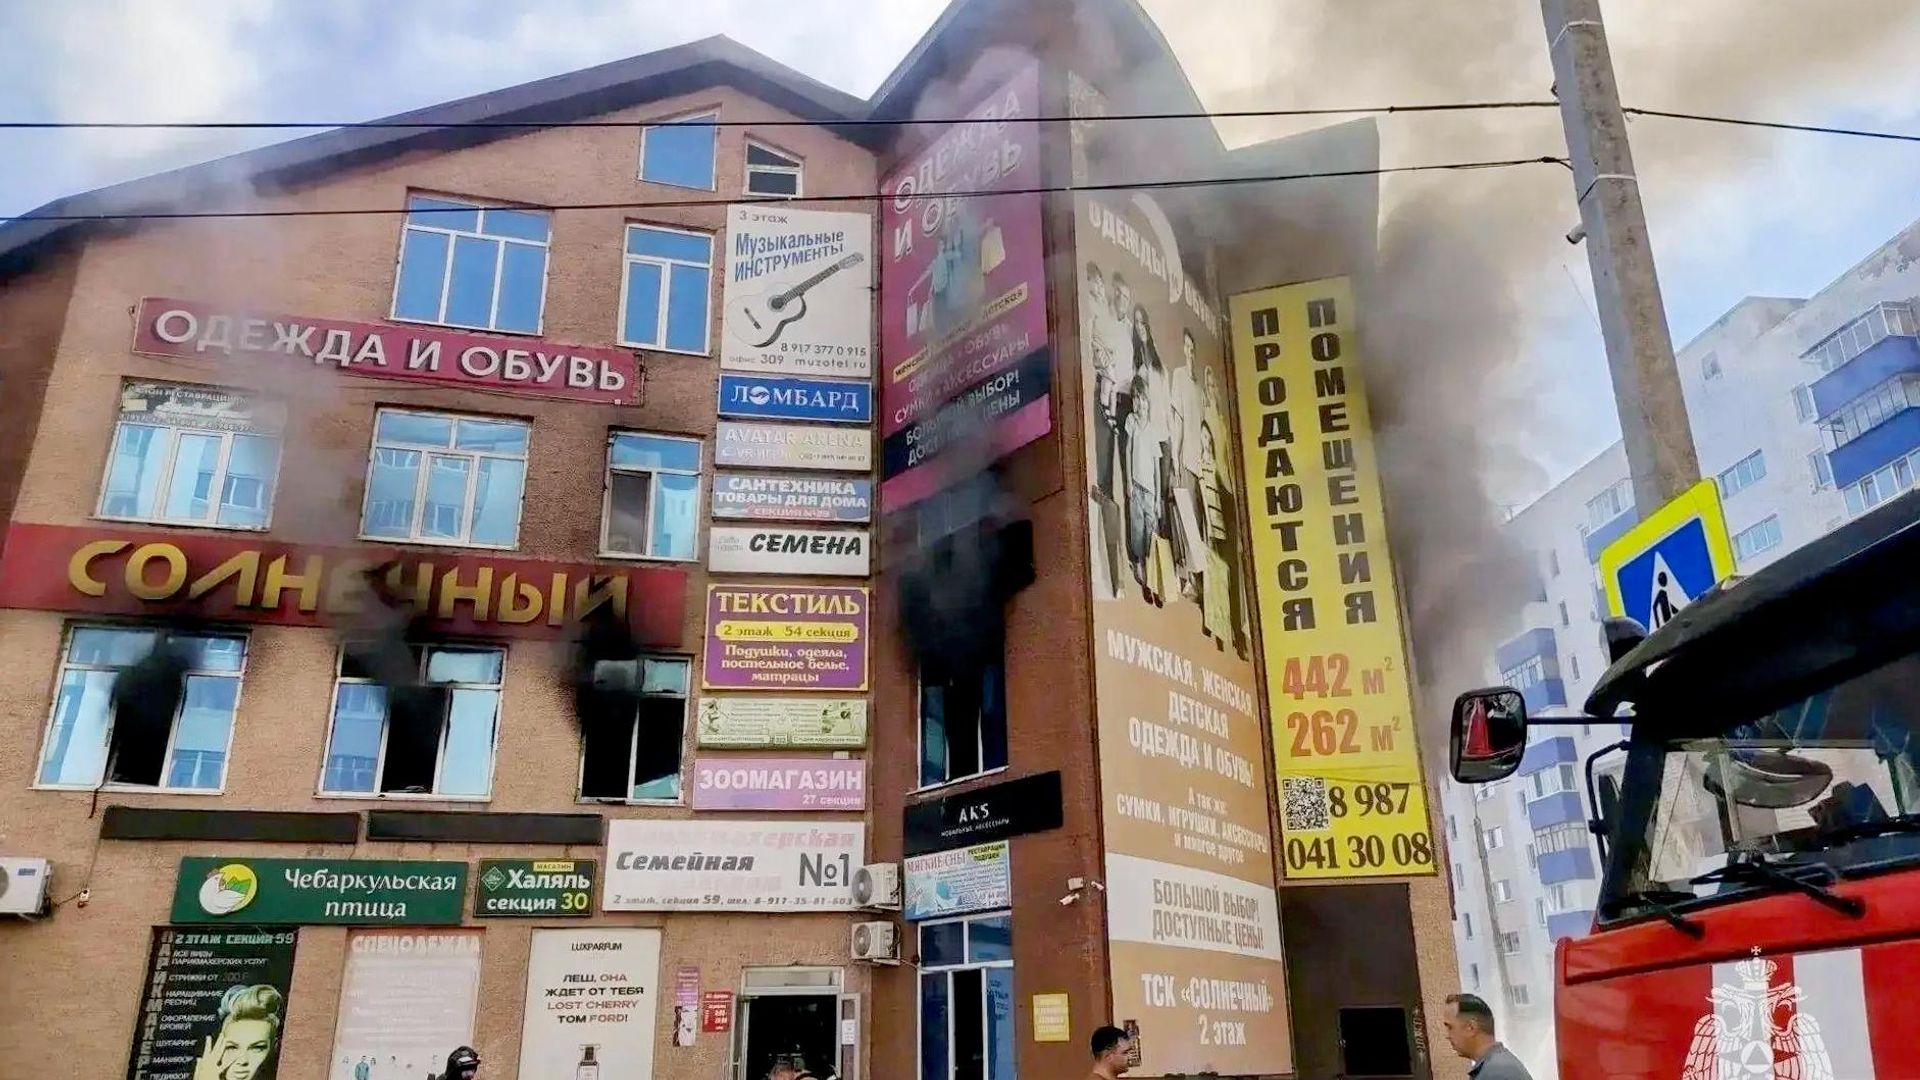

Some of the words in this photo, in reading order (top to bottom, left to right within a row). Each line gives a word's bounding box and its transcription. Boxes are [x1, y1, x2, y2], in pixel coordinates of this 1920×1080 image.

[739, 211, 748, 221] 3
[751, 215, 788, 225] этаж
[735, 231, 844, 258] Музыкальные
[894, 219, 912, 263] И
[734, 243, 844, 282] ИНСТРУМЕНТЫ
[155, 308, 388, 367] ОДЕЖДА
[408, 339, 442, 372] И
[461, 345, 627, 392] ОБУВЬ
[760, 354, 785, 365] 309
[780, 342, 788, 352] 8
[791, 344, 810, 353] 917
[814, 345, 834, 354] 377
[836, 346, 843, 356] 0
[847, 346, 866, 357] 915
[795, 357, 866, 369] muzotel.ru
[1251, 307, 1316, 632] ПРОДАЮТСЯ
[1307, 297, 1377, 624] ПОМЕЩЕНИЯ
[728, 477, 857, 495] САНТЕХНИКА
[716, 492, 783, 504] ТОВАРЫ
[785, 493, 822, 508] ДЛЯ
[821, 497, 868, 508] ДОМА
[749, 533, 861, 556] СЕМЕНА
[716, 592, 861, 615] ТЕКСТИЛЬ
[723, 625, 732, 635] 2
[736, 626, 773, 637] этаж
[784, 625, 802, 636] 54
[805, 627, 850, 639] секция
[725, 645, 793, 659] Подушки,
[797, 648, 848, 660] одеяла,
[722, 659, 804, 669] постельное
[751, 672, 820, 683] матрацы
[1106, 629, 1198, 691] МУЖСКАЯ,
[1202, 667, 1257, 724] ЖЕНСКАЯ,
[1282, 653, 1352, 700] 442
[1169, 690, 1229, 740] ДЕТСКАЯ
[1128, 716, 1200, 769] ОДЕЖДА
[1203, 741, 1213, 771] И
[1288, 708, 1361, 758] 262
[700, 769, 861, 790] ЗООМАГАЗИН
[802, 794, 816, 805] 27
[819, 794, 860, 806] секция
[1116, 793, 1165, 824] СУМКИ,
[1328, 786, 1348, 818] 8
[1354, 783, 1411, 817] 987
[1287, 835, 1340, 870] 041
[1347, 835, 1385, 868] 30
[1391, 832, 1432, 866] 08
[616, 852, 754, 872] Семейная
[285, 867, 457, 895] Чебаркульская
[506, 868, 590, 889] Халяль
[325, 899, 406, 919] птица
[487, 897, 557, 912] секция
[560, 892, 588, 910] 30
[614, 895, 621, 904] 2
[1153, 878, 1220, 914] БОЛЬШОЙ
[1223, 892, 1260, 922] ВЫБОР!
[1153, 909, 1232, 945] ДОСТУПНЫЕ
[175, 934, 184, 944] 2
[187, 934, 221, 944] ЭТАЖ
[226, 934, 273, 945] СЕКЦИЯ
[275, 933, 294, 944] 59
[352, 935, 480, 955] СПЕЦОДЕЖДА
[571, 943, 622, 951] LUXPARFUM
[600, 974, 628, 982] ОНА
[545, 988, 586, 997] ЖДЕТ
[589, 988, 607, 996] ОТ
[610, 987, 644, 996] ТЕБЯ
[1141, 973, 1177, 1007] ТСК
[1181, 977, 1273, 1013] «СОЛНЕЧНЫЙ»
[547, 1001, 585, 1010] LOST
[586, 1000, 639, 1009] CHERRY
[558, 1015, 586, 1024] TOM
[589, 1014, 628, 1023] FORD!
[1199, 1014, 1209, 1045] 2
[1214, 1020, 1246, 1045] этаж
